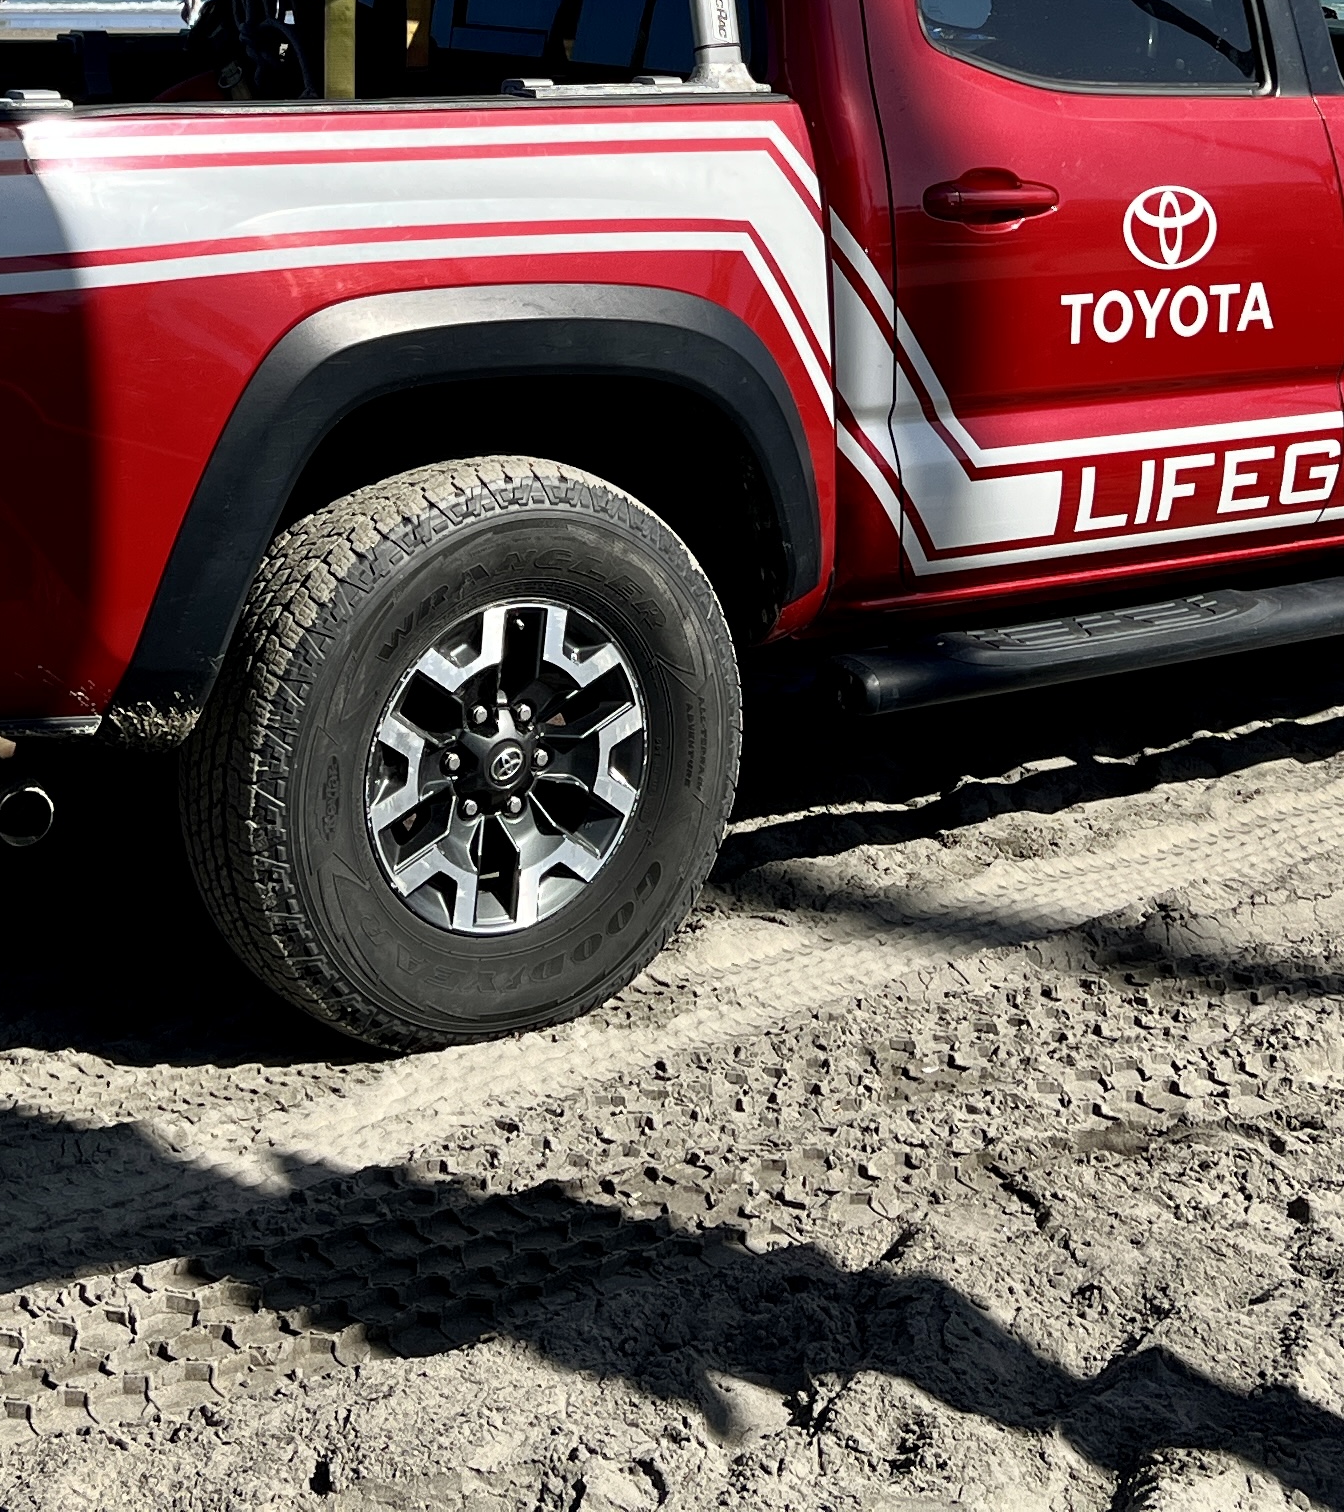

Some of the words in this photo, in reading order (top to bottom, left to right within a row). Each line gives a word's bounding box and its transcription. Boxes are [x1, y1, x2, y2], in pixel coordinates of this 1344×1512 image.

[1061, 282, 1274, 345] TOYOTA
[376, 548, 667, 662] WRANGLER
[360, 861, 661, 994] GOODYEAR
